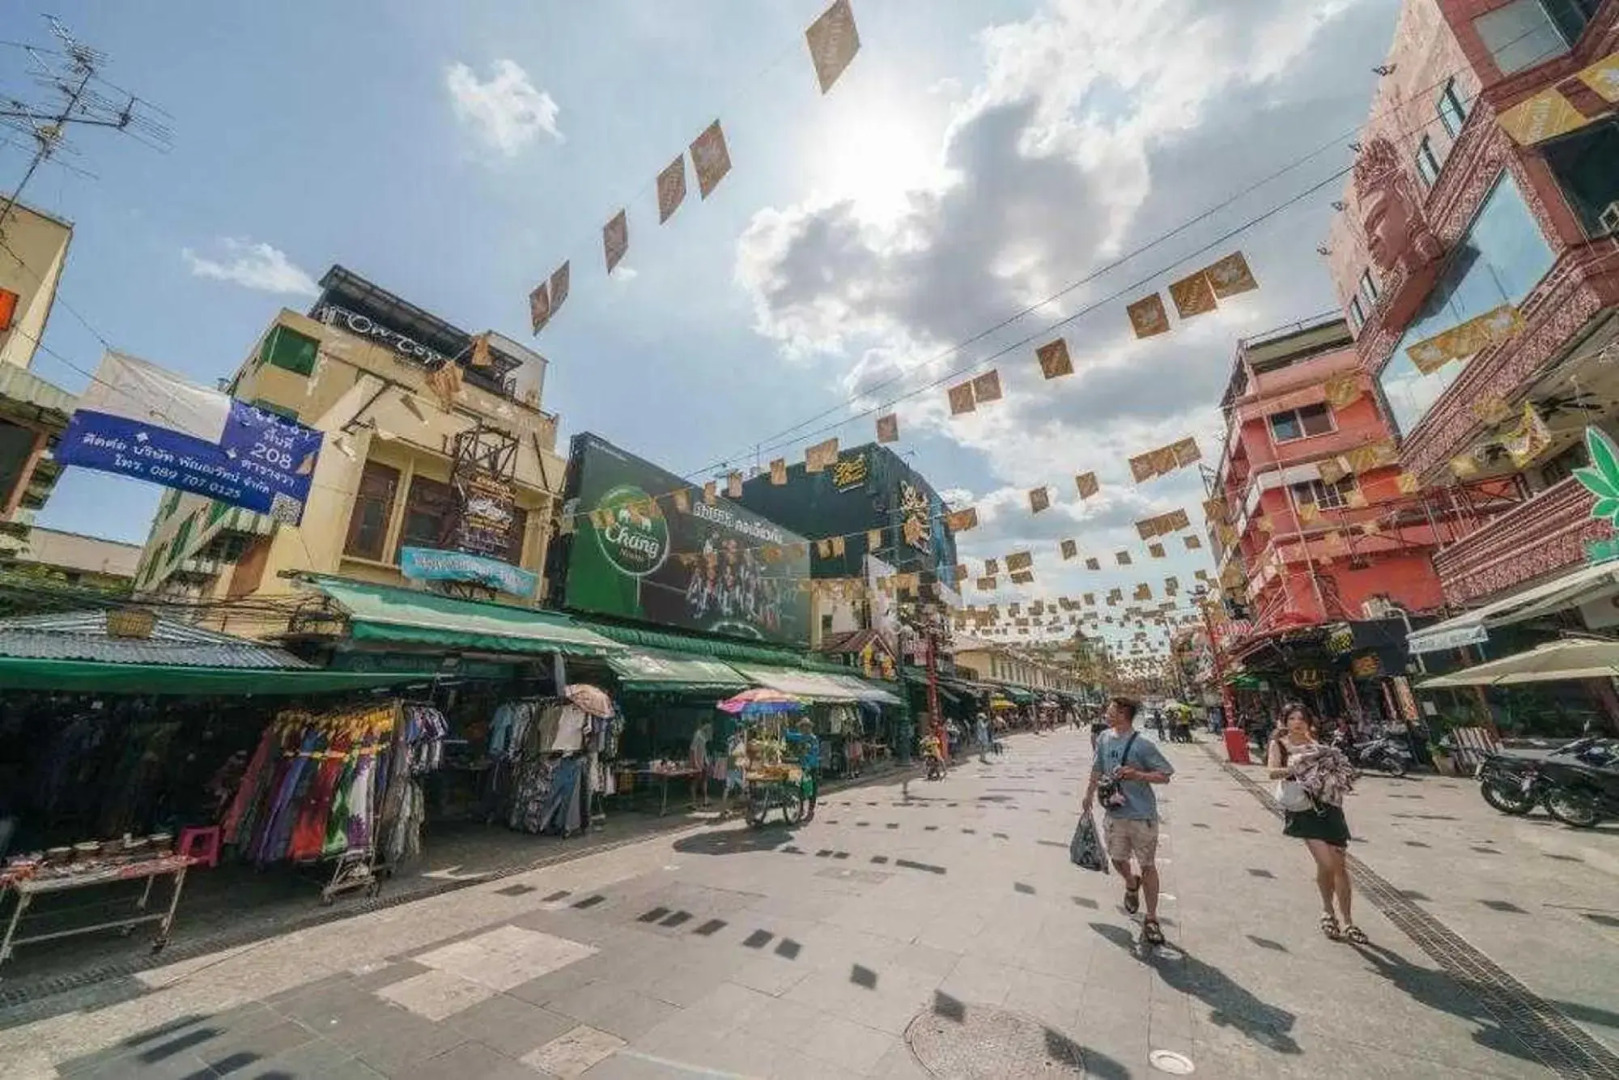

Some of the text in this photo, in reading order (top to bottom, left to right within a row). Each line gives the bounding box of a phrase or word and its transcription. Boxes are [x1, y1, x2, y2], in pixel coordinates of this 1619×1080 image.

[83, 432, 126, 451] ติดต่อ
[133, 445, 175, 463] บริษัท
[250, 442, 292, 469] 208
[150, 466, 178, 481] 089
[182, 474, 206, 487] 707
[605, 522, 660, 559] Chang
